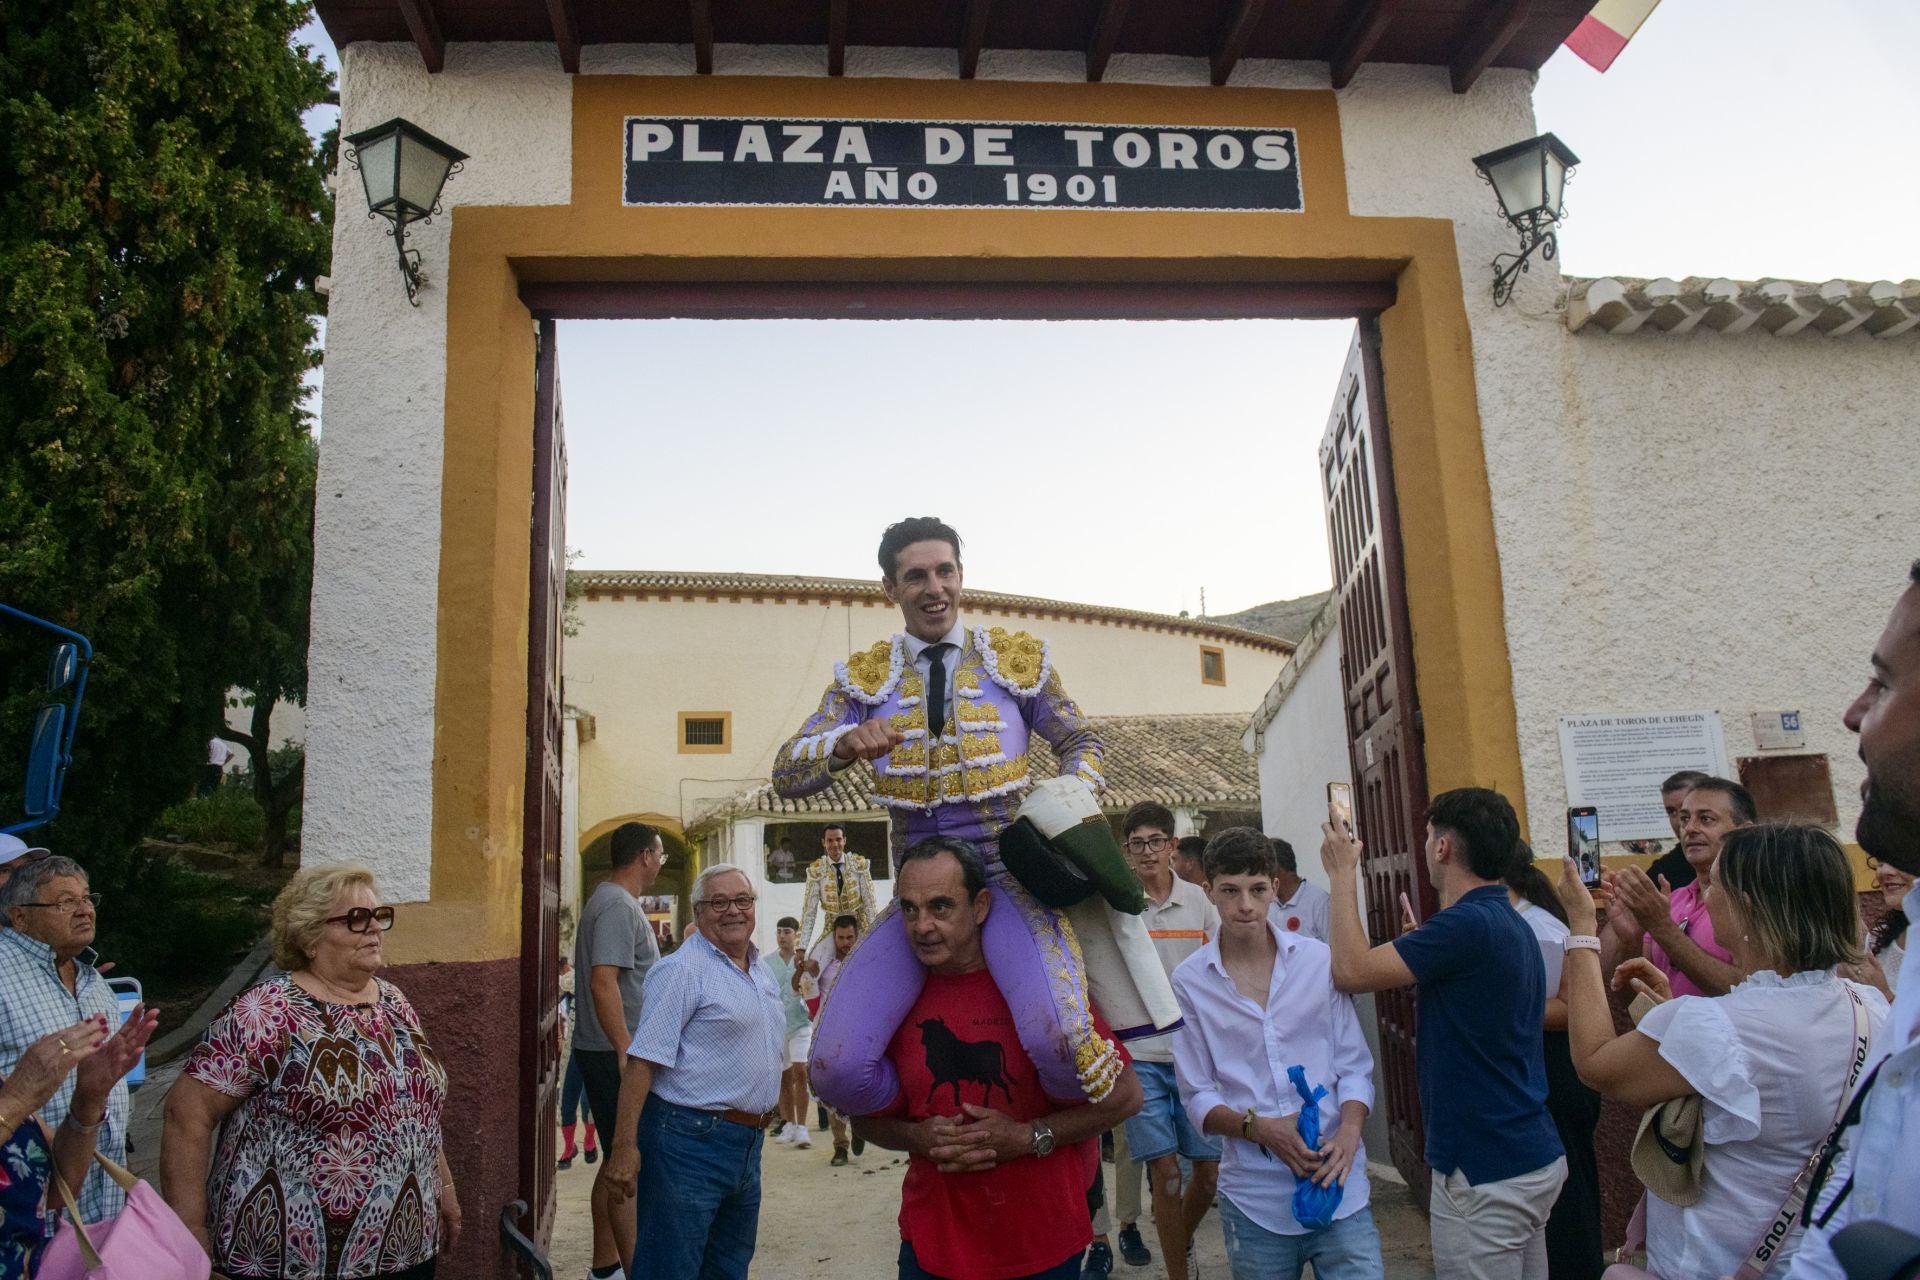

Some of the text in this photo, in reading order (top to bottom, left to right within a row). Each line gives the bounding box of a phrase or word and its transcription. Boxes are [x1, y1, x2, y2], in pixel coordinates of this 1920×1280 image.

[632, 123, 1291, 171] PLAZA DE TOROS
[823, 166, 1117, 203] AÑO 1901
[1567, 719, 1599, 729] PLAZA
[1614, 717, 1647, 726] TOROS
[1648, 716, 1660, 725] DE
[1663, 713, 1704, 723] CEHEGÍN
[1783, 716, 1798, 728] 56
[1849, 1035, 1868, 1089] TOUS
[1755, 1210, 1796, 1262] TOUS
